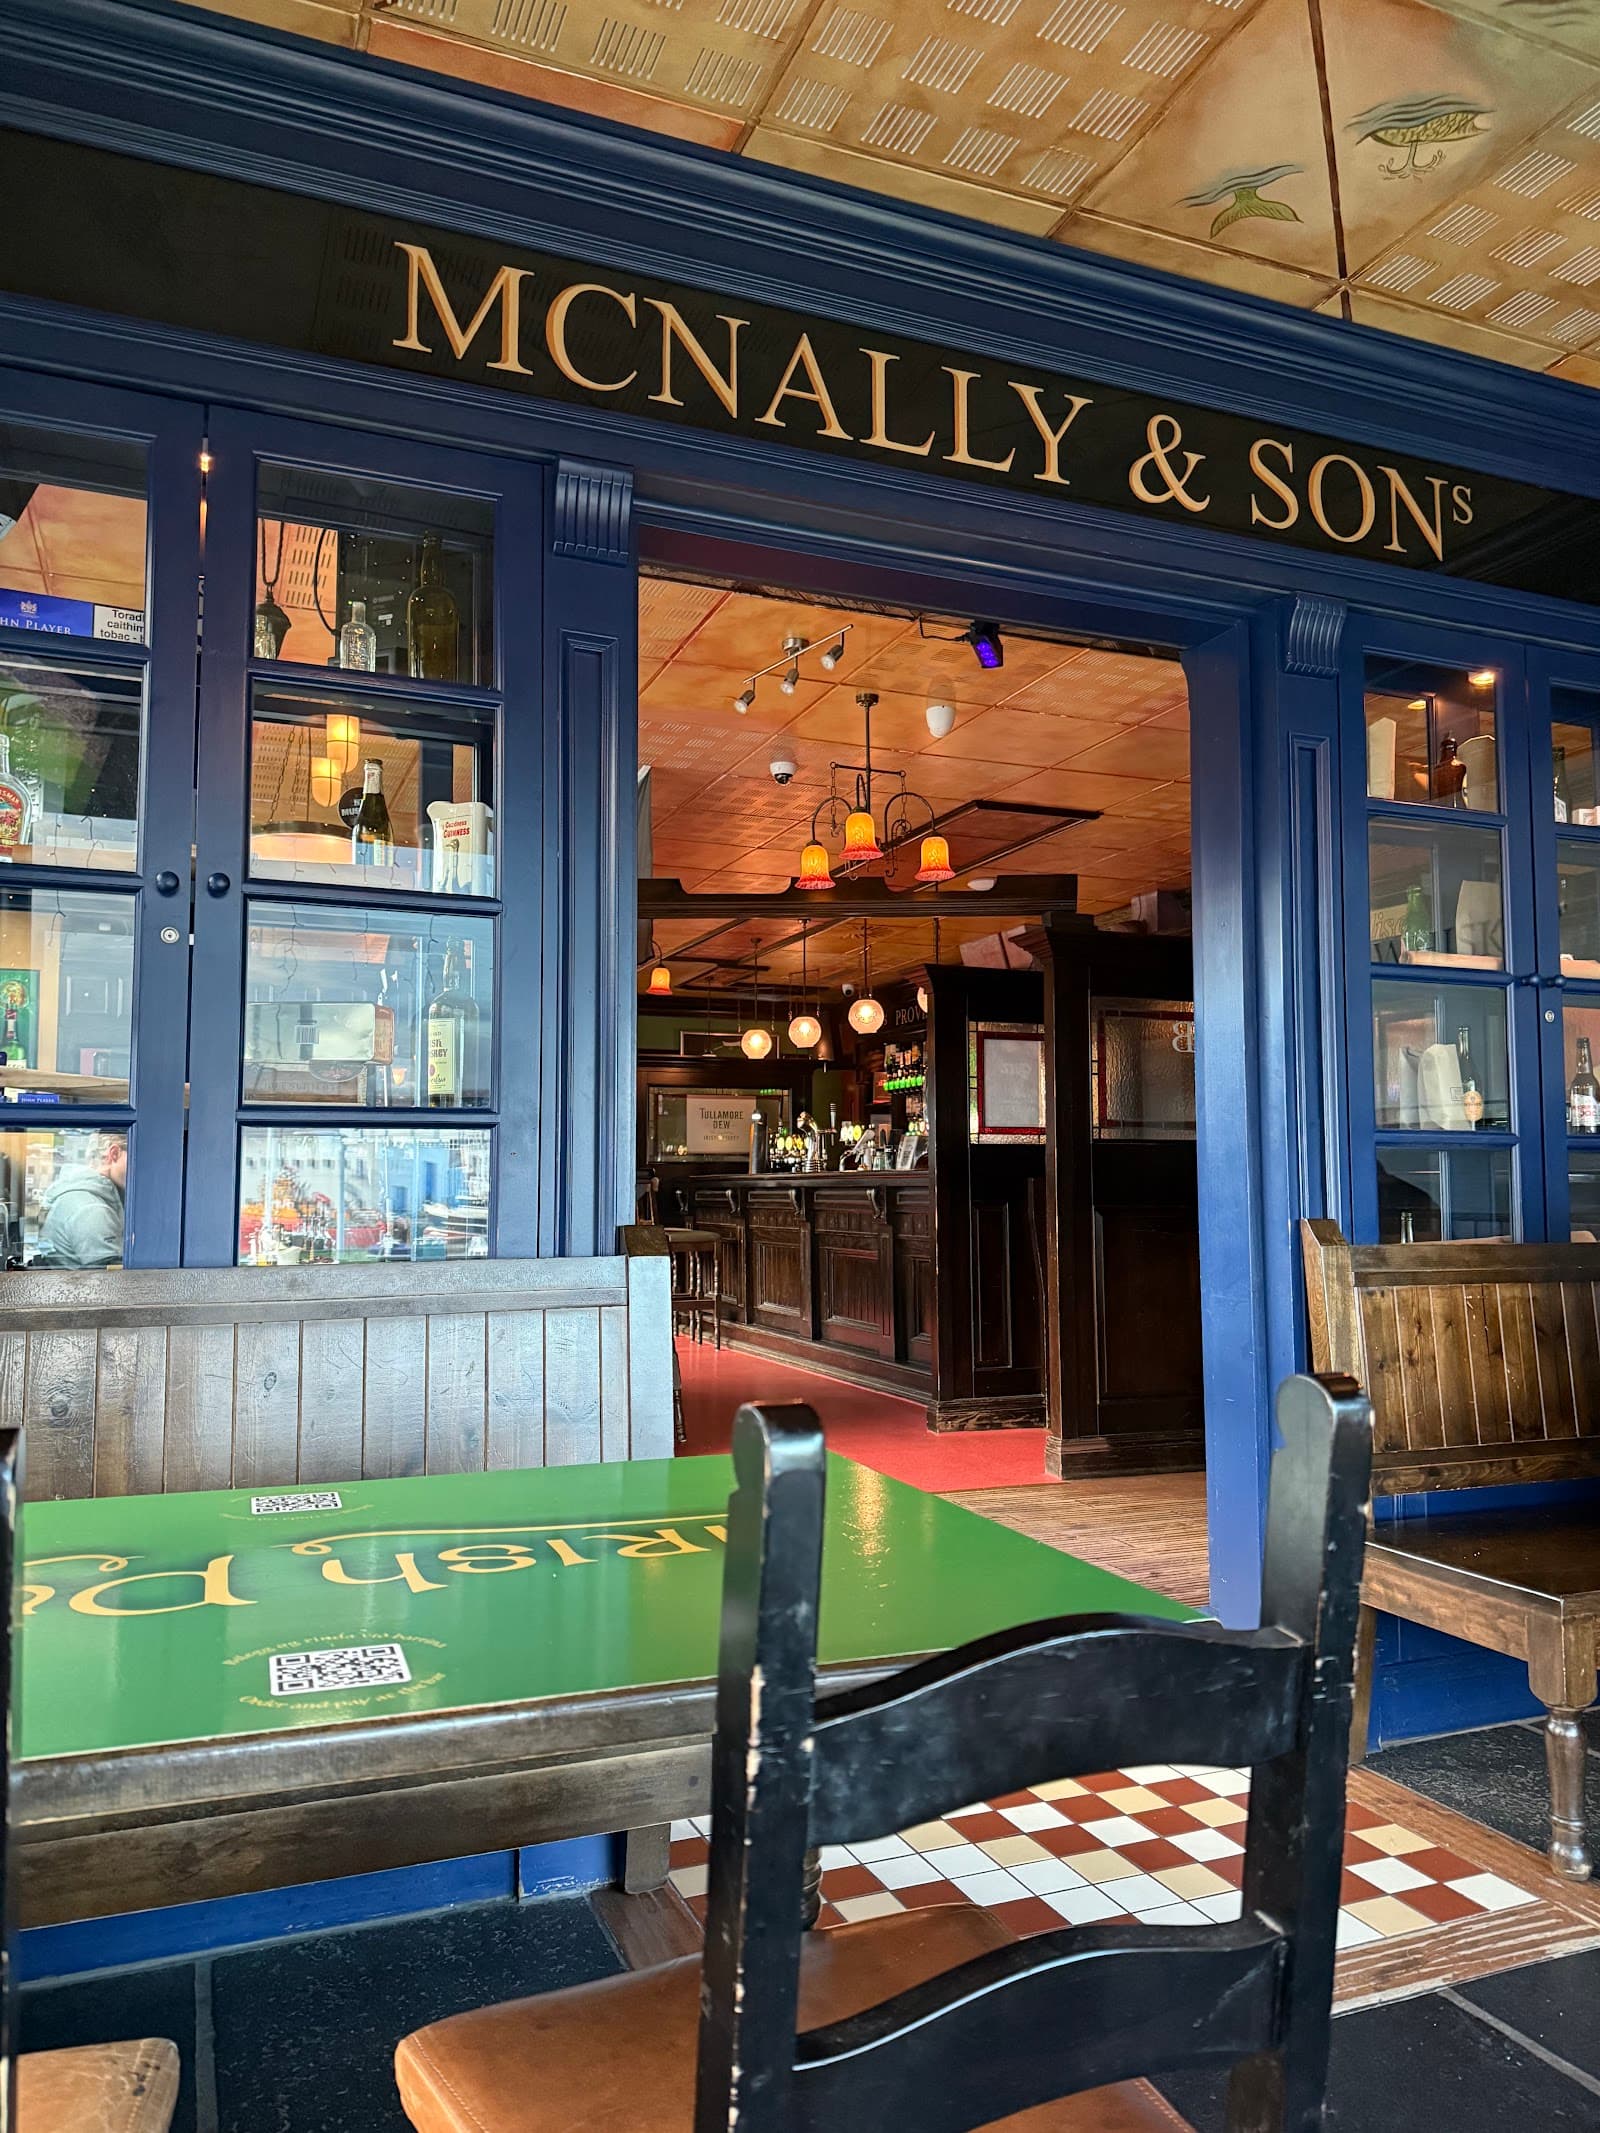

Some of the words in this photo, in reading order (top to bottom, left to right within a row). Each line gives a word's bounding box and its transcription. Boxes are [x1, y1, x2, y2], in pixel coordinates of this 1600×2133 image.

[392, 241, 1093, 486] MCNALLY
[1128, 414, 1211, 513] &
[111, 609, 144, 622] Torad
[0, 616, 20, 628] HN
[26, 619, 72, 635] PLAYER
[100, 628, 130, 641] tobac
[712, 1120, 731, 1130] DEW
